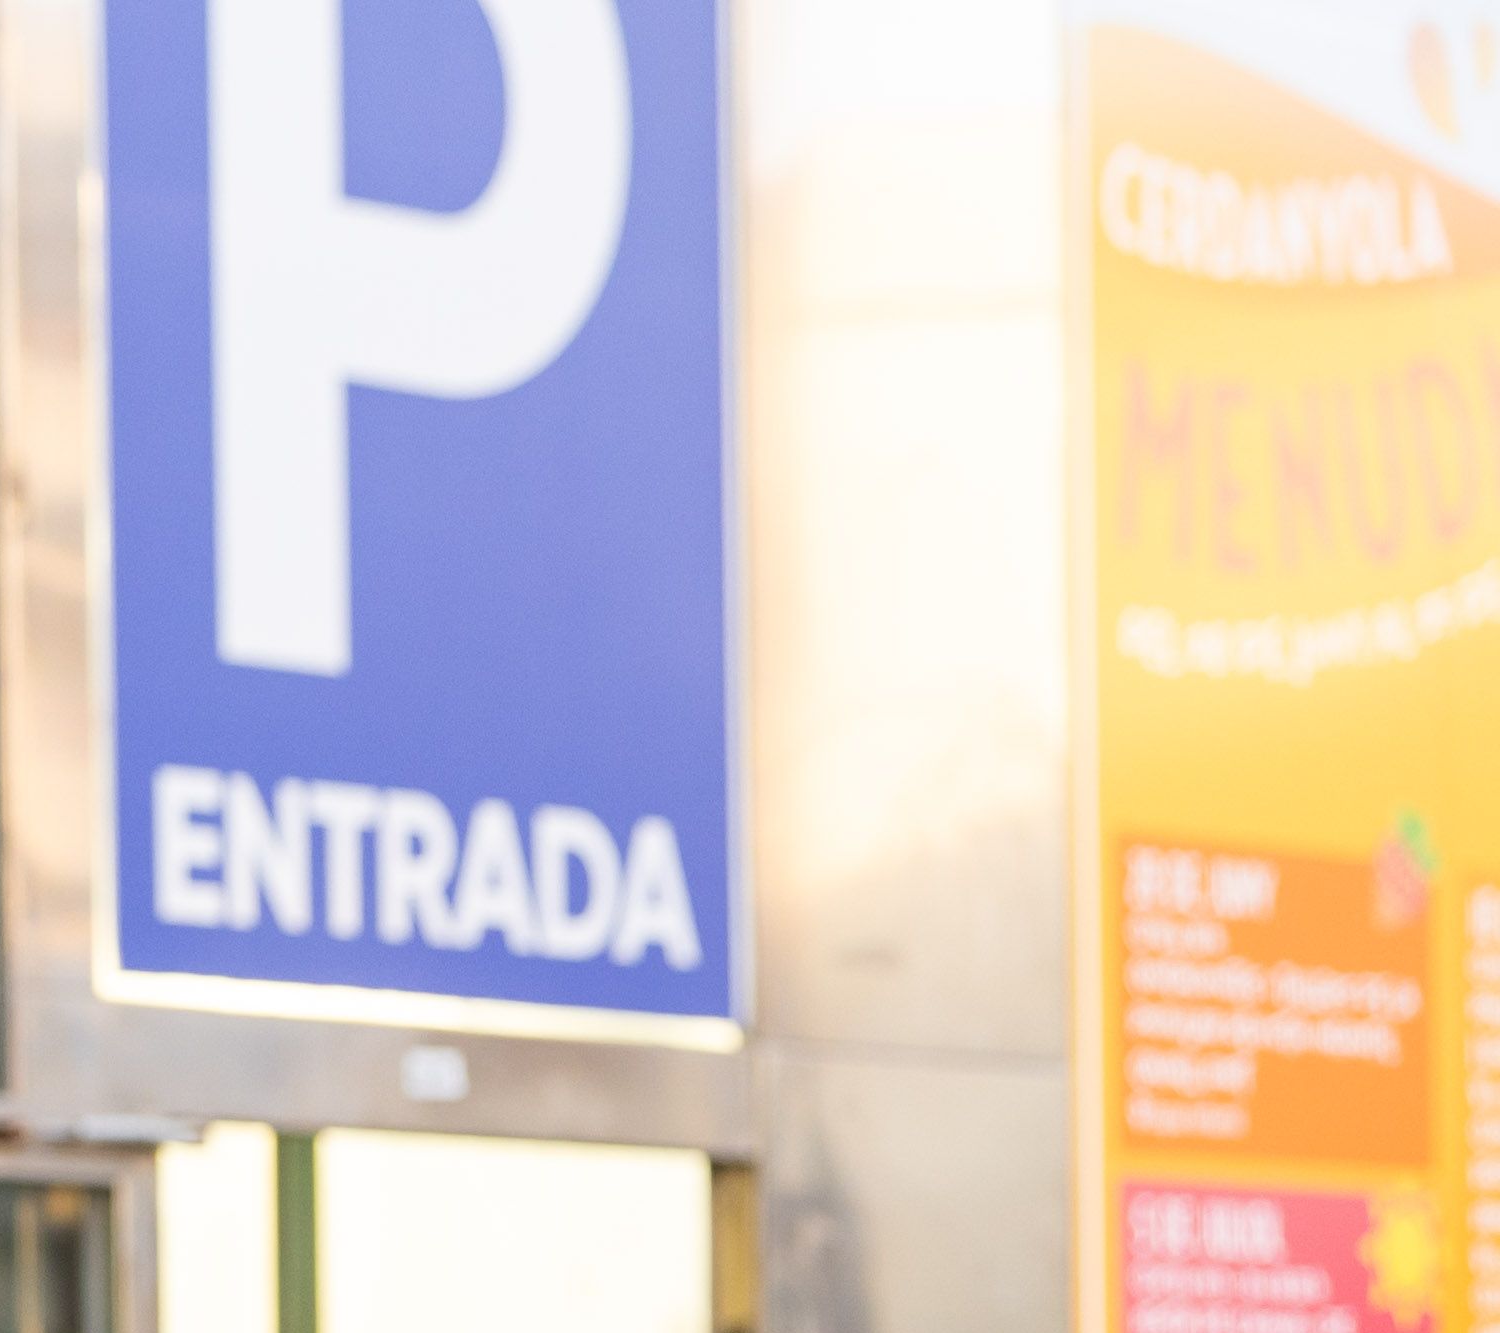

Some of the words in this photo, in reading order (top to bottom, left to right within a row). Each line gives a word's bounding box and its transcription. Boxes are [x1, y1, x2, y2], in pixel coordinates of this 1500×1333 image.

[207, 0, 633, 678] P
[1115, 345, 1500, 578] MENUD
[153, 763, 702, 970] ENTRADA
